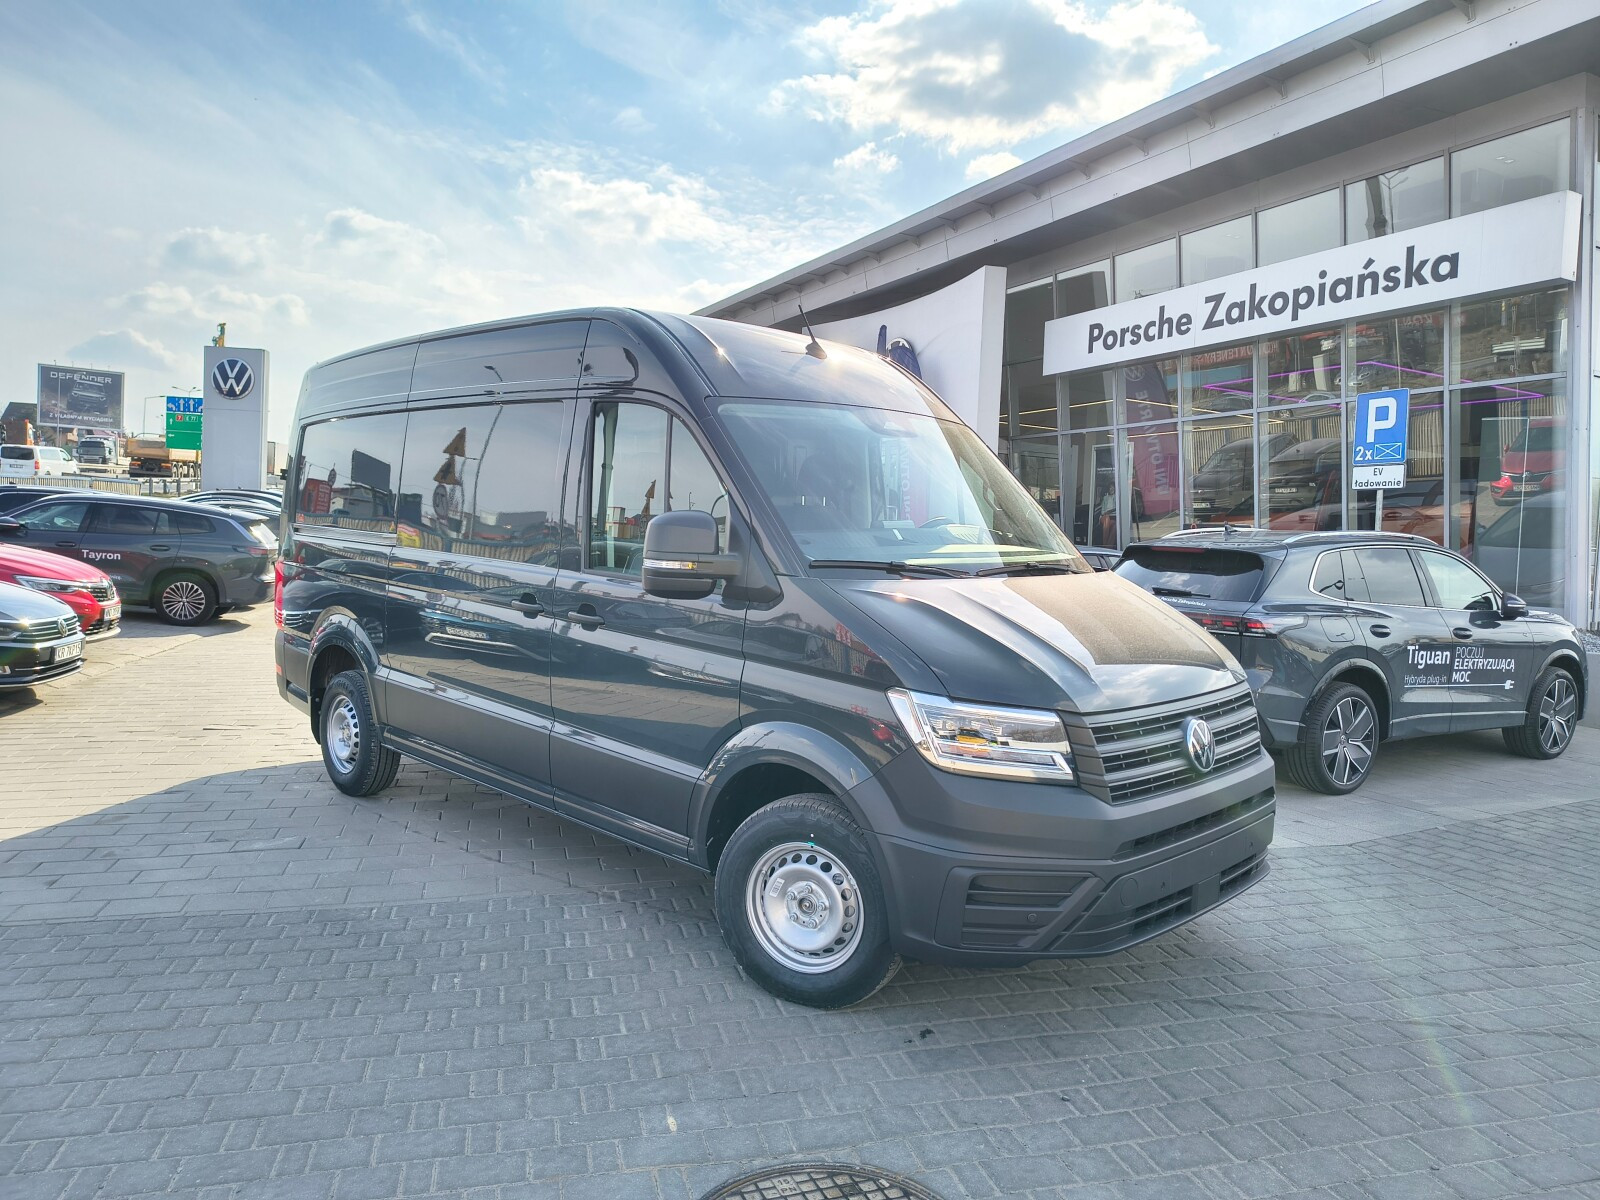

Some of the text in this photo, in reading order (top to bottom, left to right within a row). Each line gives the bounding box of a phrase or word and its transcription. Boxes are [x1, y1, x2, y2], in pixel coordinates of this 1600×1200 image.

[1088, 246, 1460, 354] Porsche Zakopiańska
[50, 371, 112, 384] DEFENDER
[1366, 397, 1397, 443] P
[1355, 446, 1373, 461] 2x
[1373, 468, 1383, 476] EV
[1354, 478, 1402, 488] ładowanie
[82, 550, 121, 560] Tayron
[1407, 645, 1450, 669] Tiguan
[1455, 647, 1484, 658] POCZUJ
[1454, 659, 1515, 672] ELEKTRYZUJĄCĄ
[1404, 675, 1447, 685] Hybryda plug-in
[1452, 671, 1471, 682] MOC
